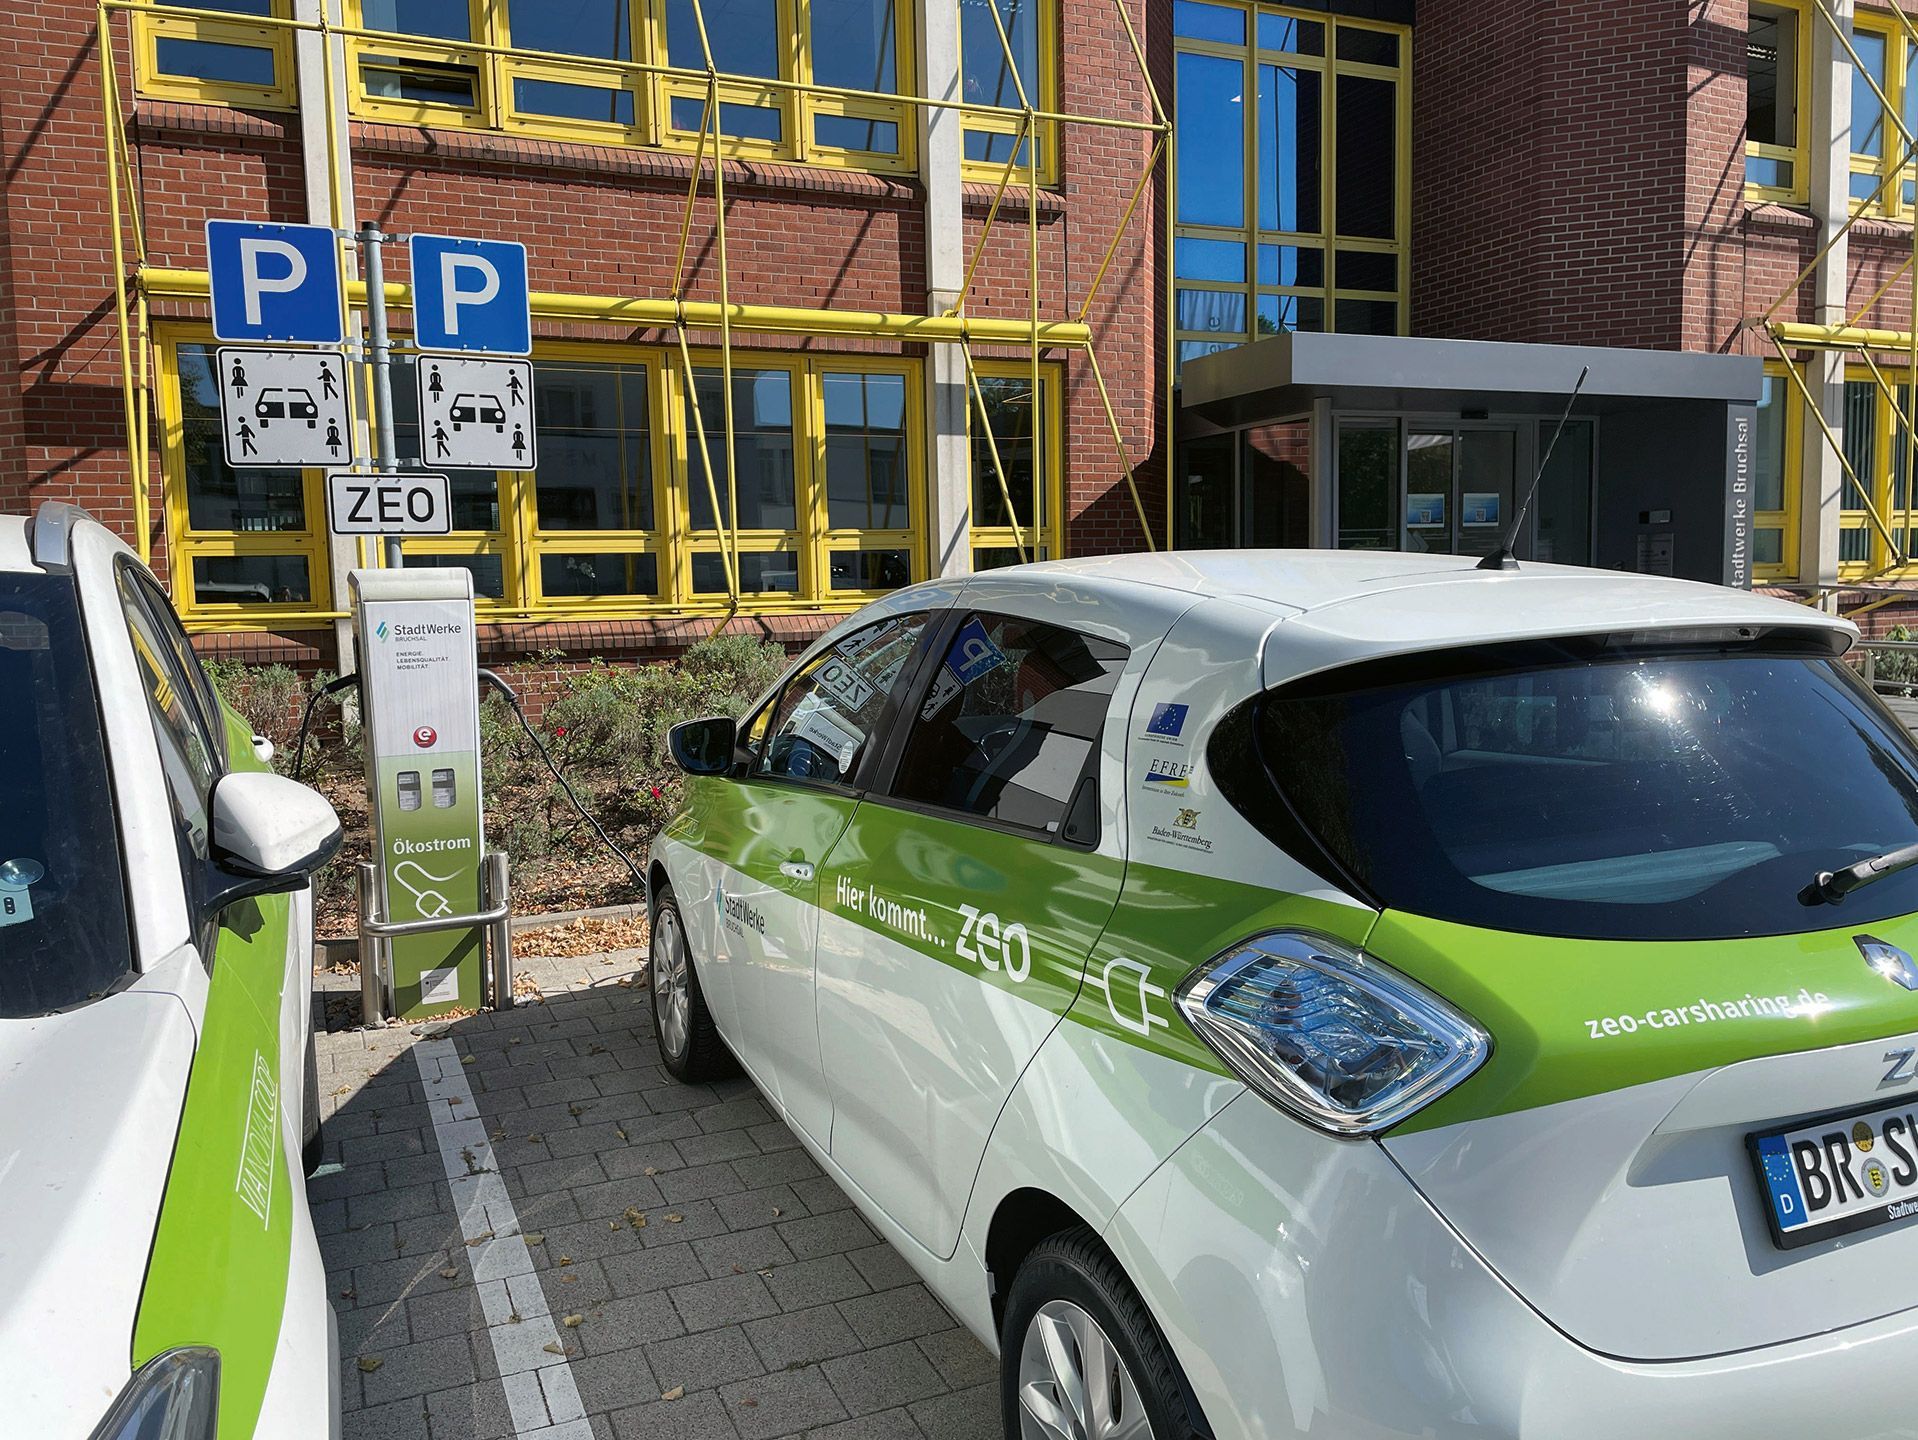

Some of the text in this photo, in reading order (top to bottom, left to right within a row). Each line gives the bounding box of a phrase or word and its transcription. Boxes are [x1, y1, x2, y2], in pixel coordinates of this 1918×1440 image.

[240, 238, 307, 325] P
[440, 252, 500, 335] P
[346, 487, 435, 523] ZEO
[1731, 417, 1748, 590] tadtwerke Bruchsal
[394, 623, 462, 636] StadtWerke
[1150, 758, 1189, 778] EFRE
[393, 837, 471, 854] Ökostrom
[725, 891, 765, 935] StadtWerke
[836, 874, 1031, 983] Hier kommt... zeo
[1584, 988, 1830, 1040] zeo-carsharingde
[1780, 1193, 1794, 1214] D
